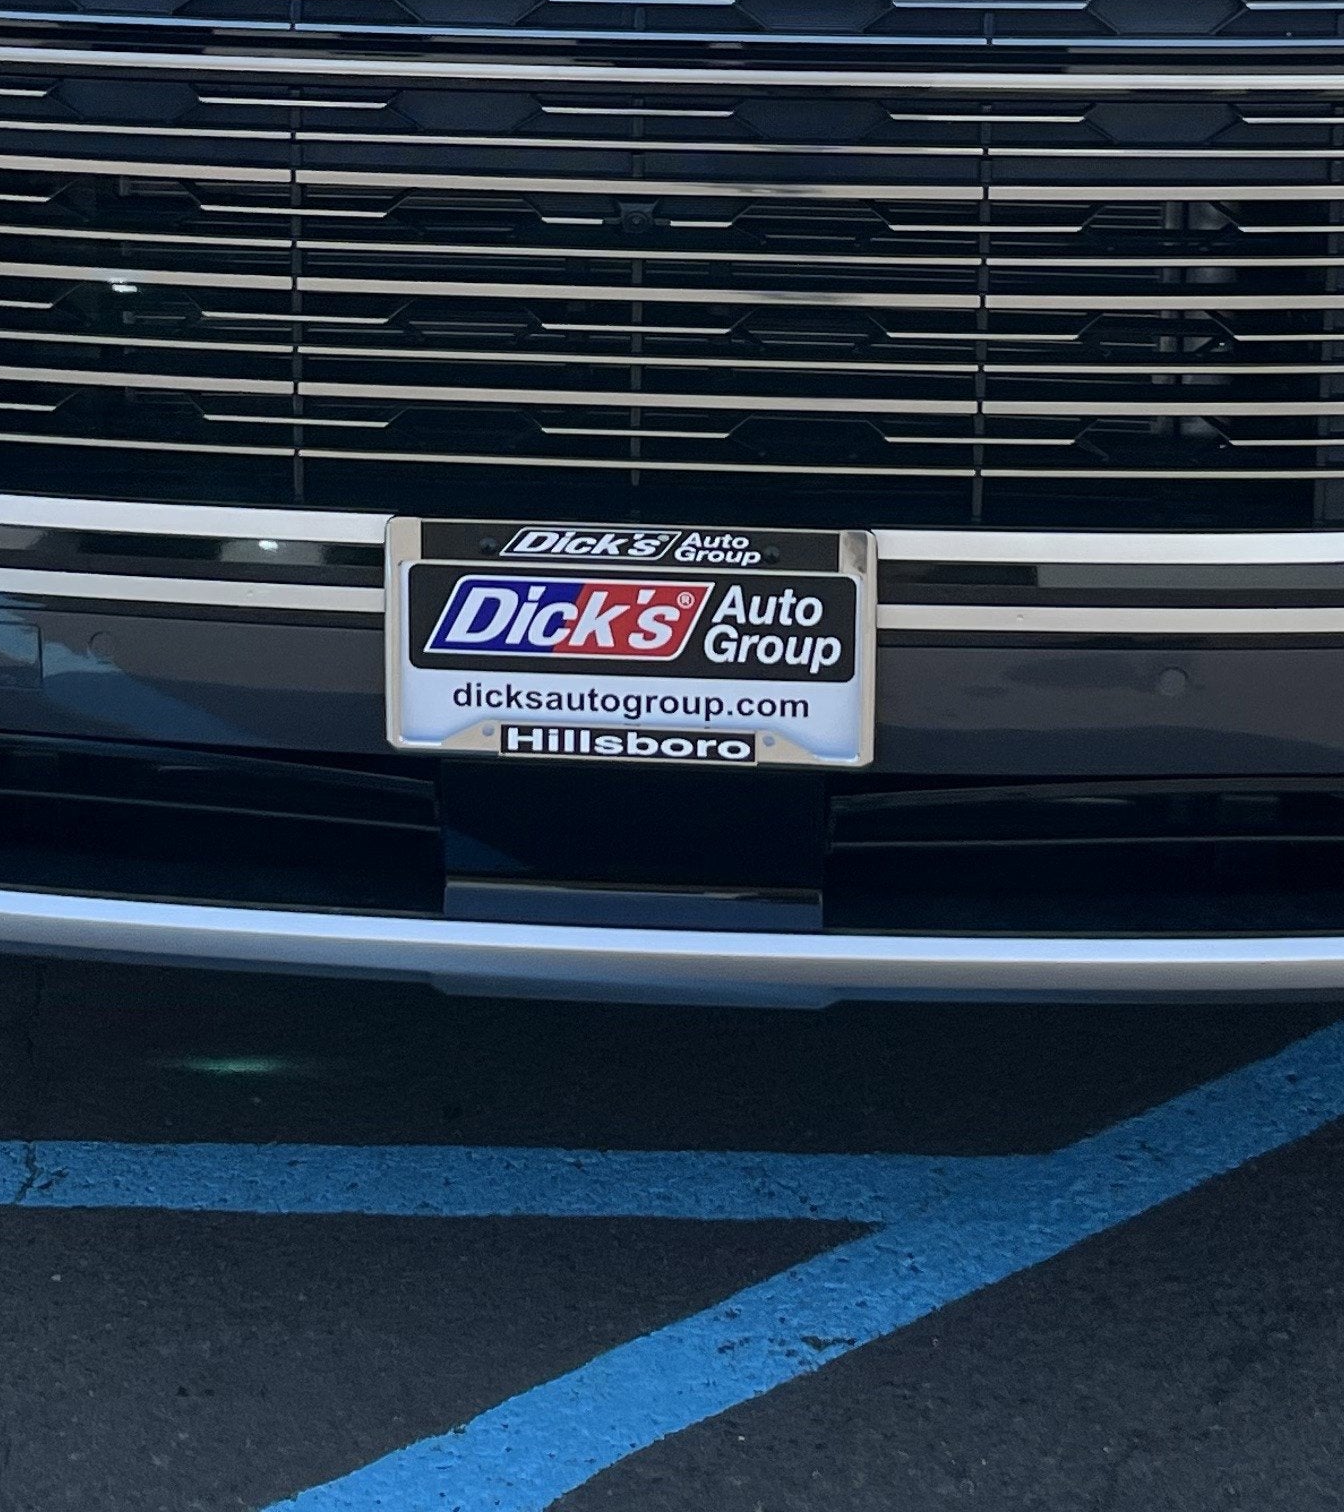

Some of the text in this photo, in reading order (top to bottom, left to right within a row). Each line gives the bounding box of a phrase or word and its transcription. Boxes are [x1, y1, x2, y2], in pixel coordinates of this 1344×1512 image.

[513, 530, 750, 557] Dick's Auto
[674, 546, 762, 566] Group
[445, 585, 823, 648] Dick's Auto
[704, 625, 842, 674] Group
[453, 683, 810, 721] dicksautogroup.com
[507, 727, 751, 760] Hillsboro
